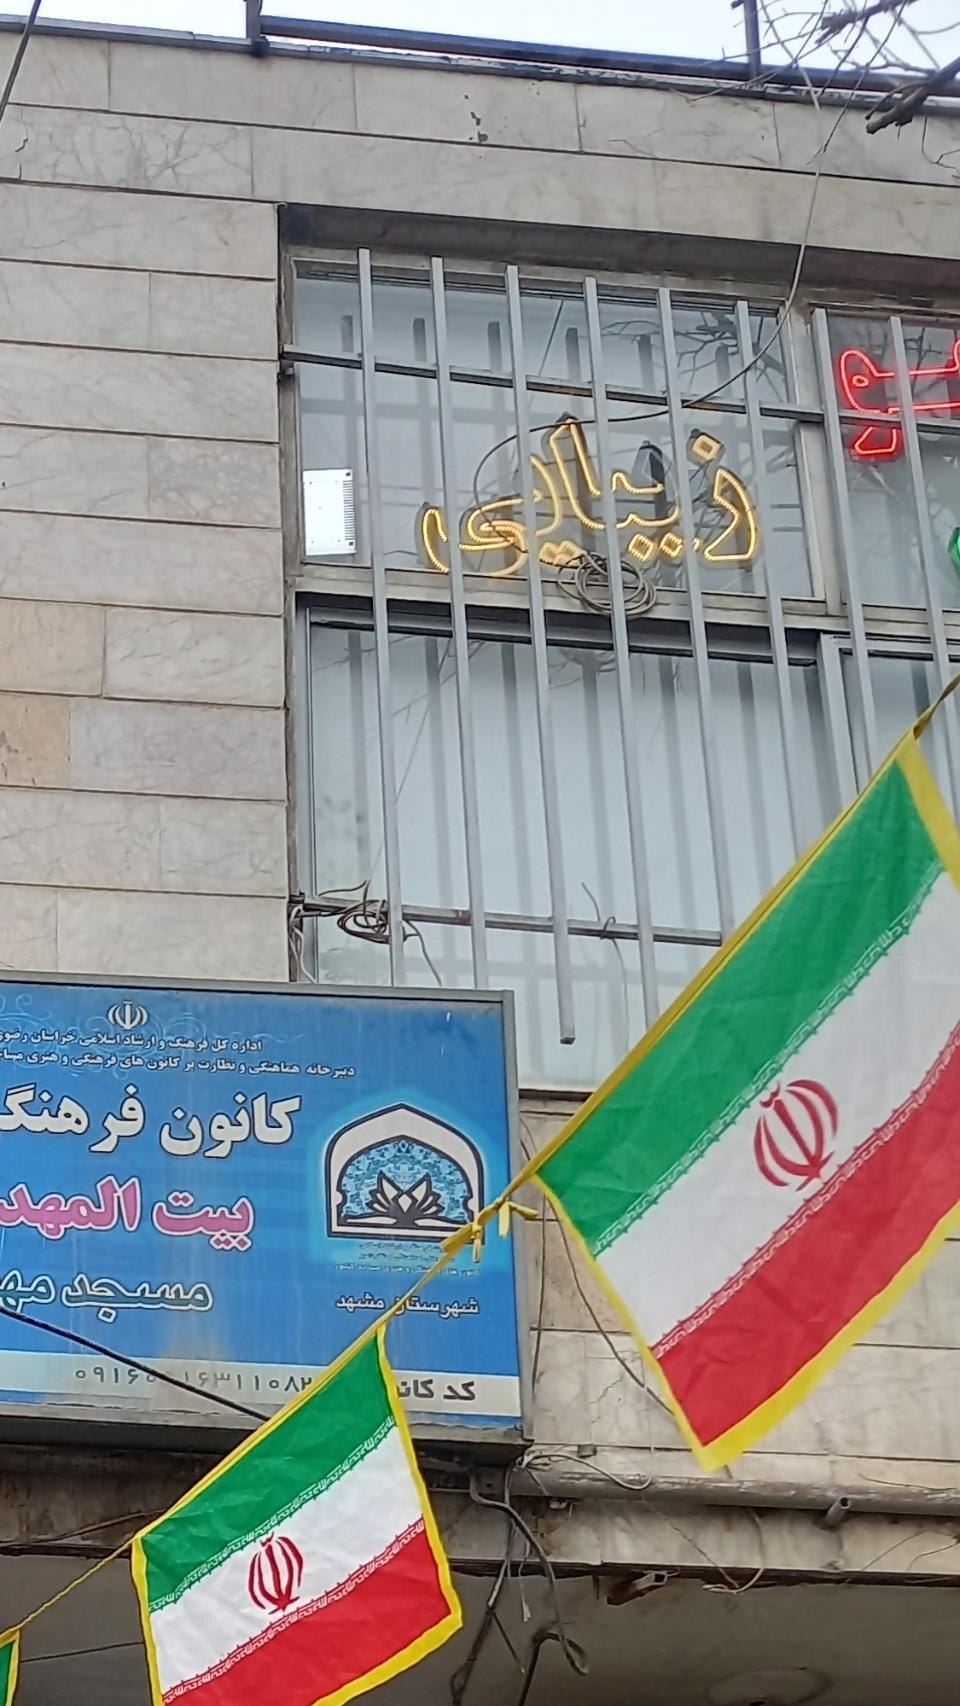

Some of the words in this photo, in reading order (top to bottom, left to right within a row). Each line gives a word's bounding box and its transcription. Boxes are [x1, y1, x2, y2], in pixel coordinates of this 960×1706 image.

[31, 1031, 76, 1046] خراسان
[79, 1033, 121, 1047] اسلامی
[123, 1034, 156, 1049] ارشاد
[168, 1035, 209, 1052] فرهنگ
[211, 1037, 229, 1052] کل
[232, 1039, 263, 1053] اداره
[26, 1050, 59, 1064] هنری
[71, 1052, 117, 1068] فرهنگی
[119, 1054, 144, 1069] های
[146, 1055, 181, 1071] کانون
[197, 1057, 236, 1072] نظارت
[183, 1059, 195, 1072] بر
[248, 1061, 300, 1075] هماهنگی
[306, 1063, 357, 1079] دبیرخانه
[159, 1093, 301, 1158] کانون
[152, 1190, 255, 1251] بیت
[61, 1273, 214, 1323] مسجد
[336, 1291, 385, 1312] مشهد
[396, 1379, 435, 1399] کان
[442, 1380, 477, 1401] کد
